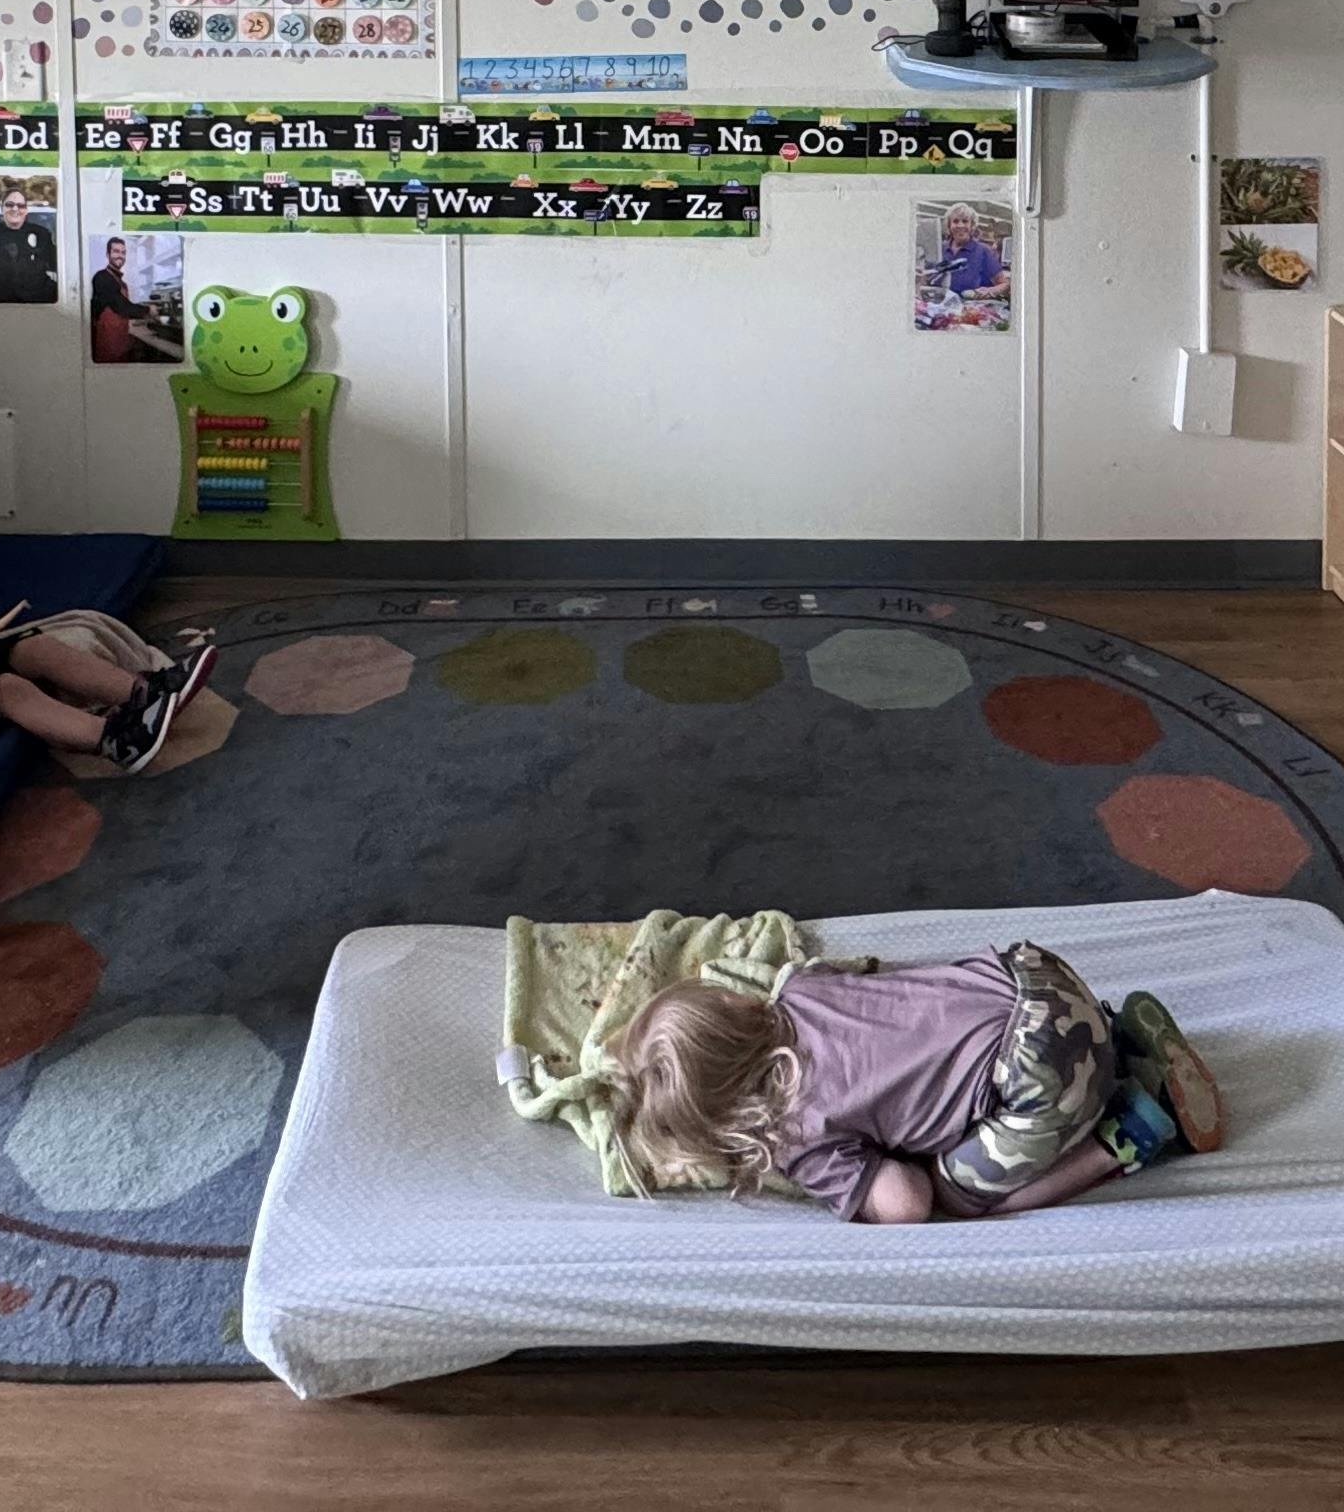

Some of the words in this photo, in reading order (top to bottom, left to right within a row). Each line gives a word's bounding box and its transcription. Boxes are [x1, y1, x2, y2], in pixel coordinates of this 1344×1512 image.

[208, 20, 230, 35] 24
[247, 18, 265, 34] 25
[280, 19, 301, 36] 26
[320, 23, 338, 37] 27
[358, 23, 377, 38] 28
[463, 59, 475, 78] 1
[484, 59, 497, 79] 2
[505, 59, 518, 79] 3
[523, 58, 536, 78] 4
[542, 58, 554, 79] 5
[559, 58, 573, 79] 6
[578, 56, 591, 77] 7
[604, 56, 616, 77] 8
[625, 57, 637, 76] 9
[647, 55, 671, 77] 10
[4, 122, 48, 150] Dd
[85, 123, 121, 149] Ee
[150, 121, 182, 149] Ff
[209, 122, 252, 154] Gg
[281, 122, 328, 148] Hh
[354, 123, 377, 149] Ii
[412, 124, 439, 156] Jj
[476, 122, 519, 150] Kk
[556, 122, 584, 150] Ll
[622, 124, 682, 151] Mm
[718, 127, 763, 153] Nn
[799, 128, 844, 155] Oo
[879, 129, 918, 160] Pp
[948, 130, 994, 162] Qq
[124, 187, 160, 212] Rr
[190, 186, 223, 213] Ss
[239, 187, 273, 212] Tt
[299, 187, 341, 213] Uu
[366, 187, 408, 213] Vv
[433, 188, 493, 213] Ww
[532, 192, 577, 218] Xx
[611, 194, 651, 225] Yy
[686, 194, 723, 220] Zz
[745, 210, 758, 220] 19
[513, 599, 549, 614] Ee
[645, 598, 674, 614] Ff
[759, 597, 800, 615] Gg
[878, 597, 926, 615] Hh
[1281, 755, 1332, 778] Ll
[40, 1274, 120, 1334] Uu
